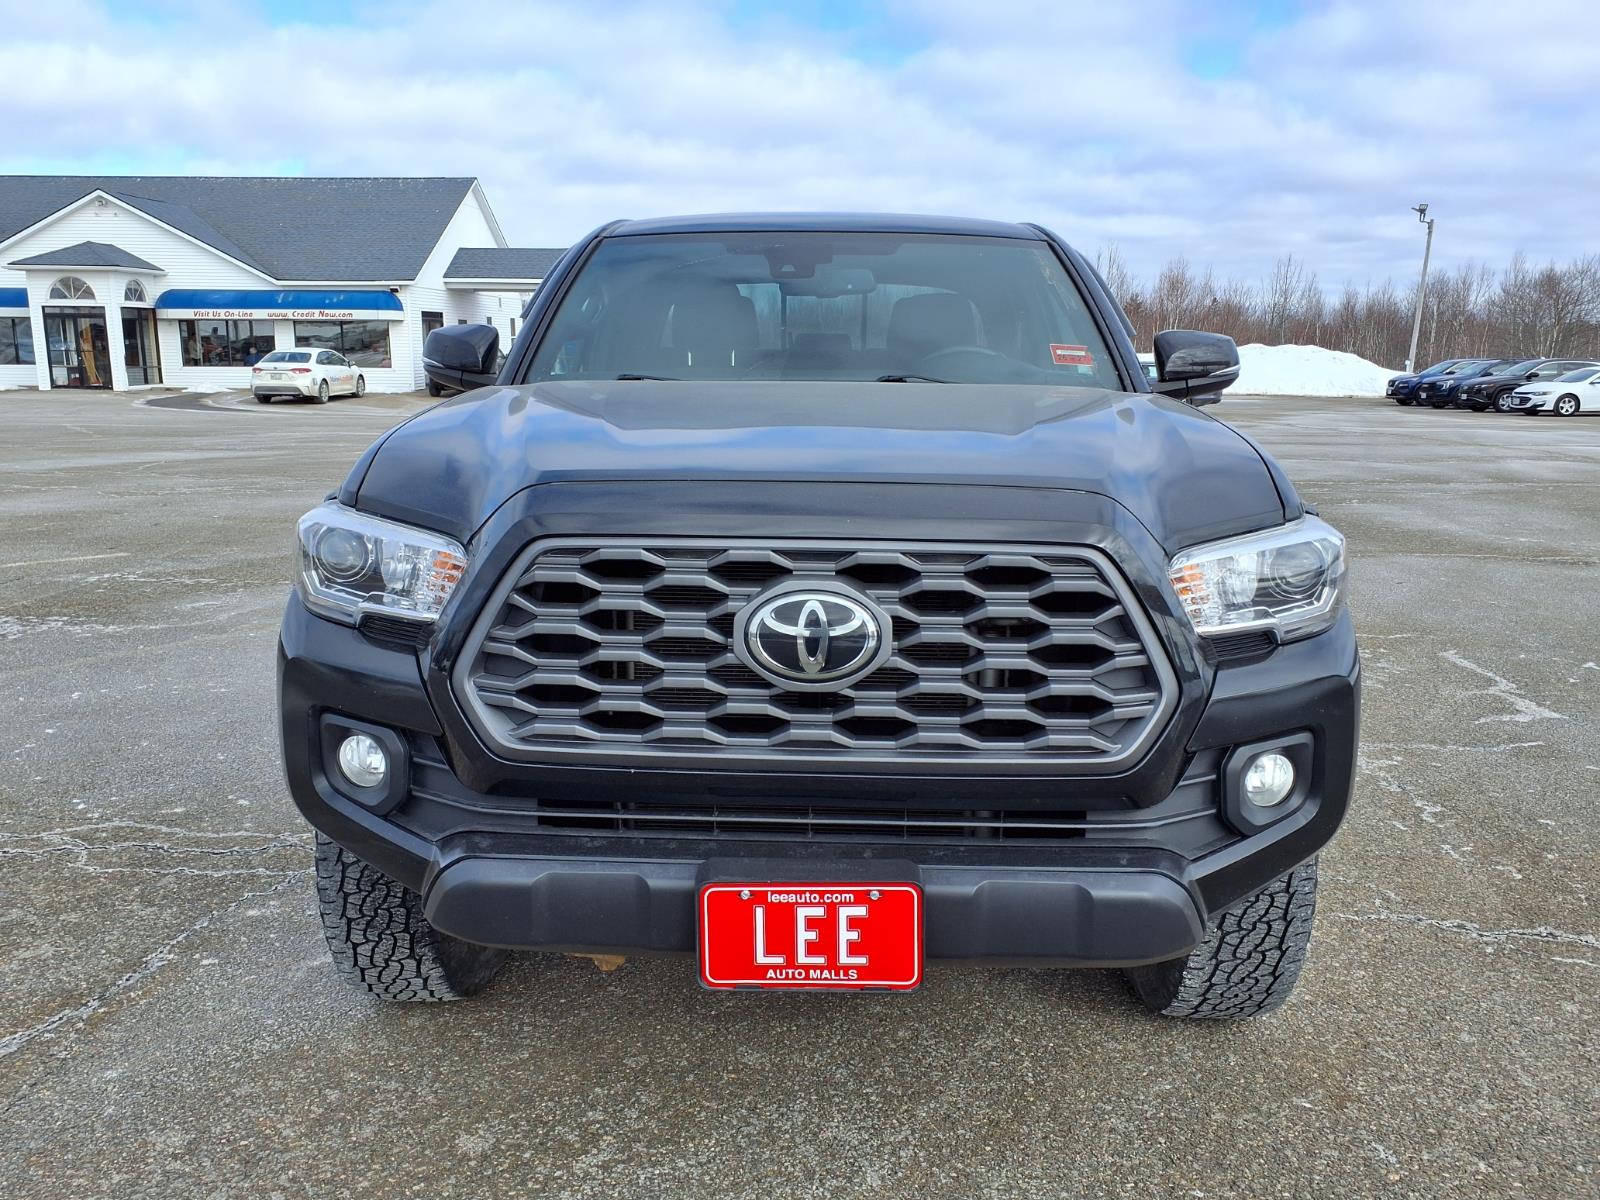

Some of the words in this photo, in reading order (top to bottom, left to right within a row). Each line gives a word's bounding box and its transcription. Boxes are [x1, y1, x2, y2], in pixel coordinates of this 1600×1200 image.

[193, 310, 210, 318] Visit
[212, 310, 221, 318] Us
[224, 310, 253, 318] On-Line
[291, 310, 316, 318] Credit
[318, 310, 353, 318] Now.com
[767, 891, 855, 903] leeauto.com
[753, 904, 869, 966] LEE
[766, 969, 806, 980] AUTO
[809, 969, 858, 980] MALLS
